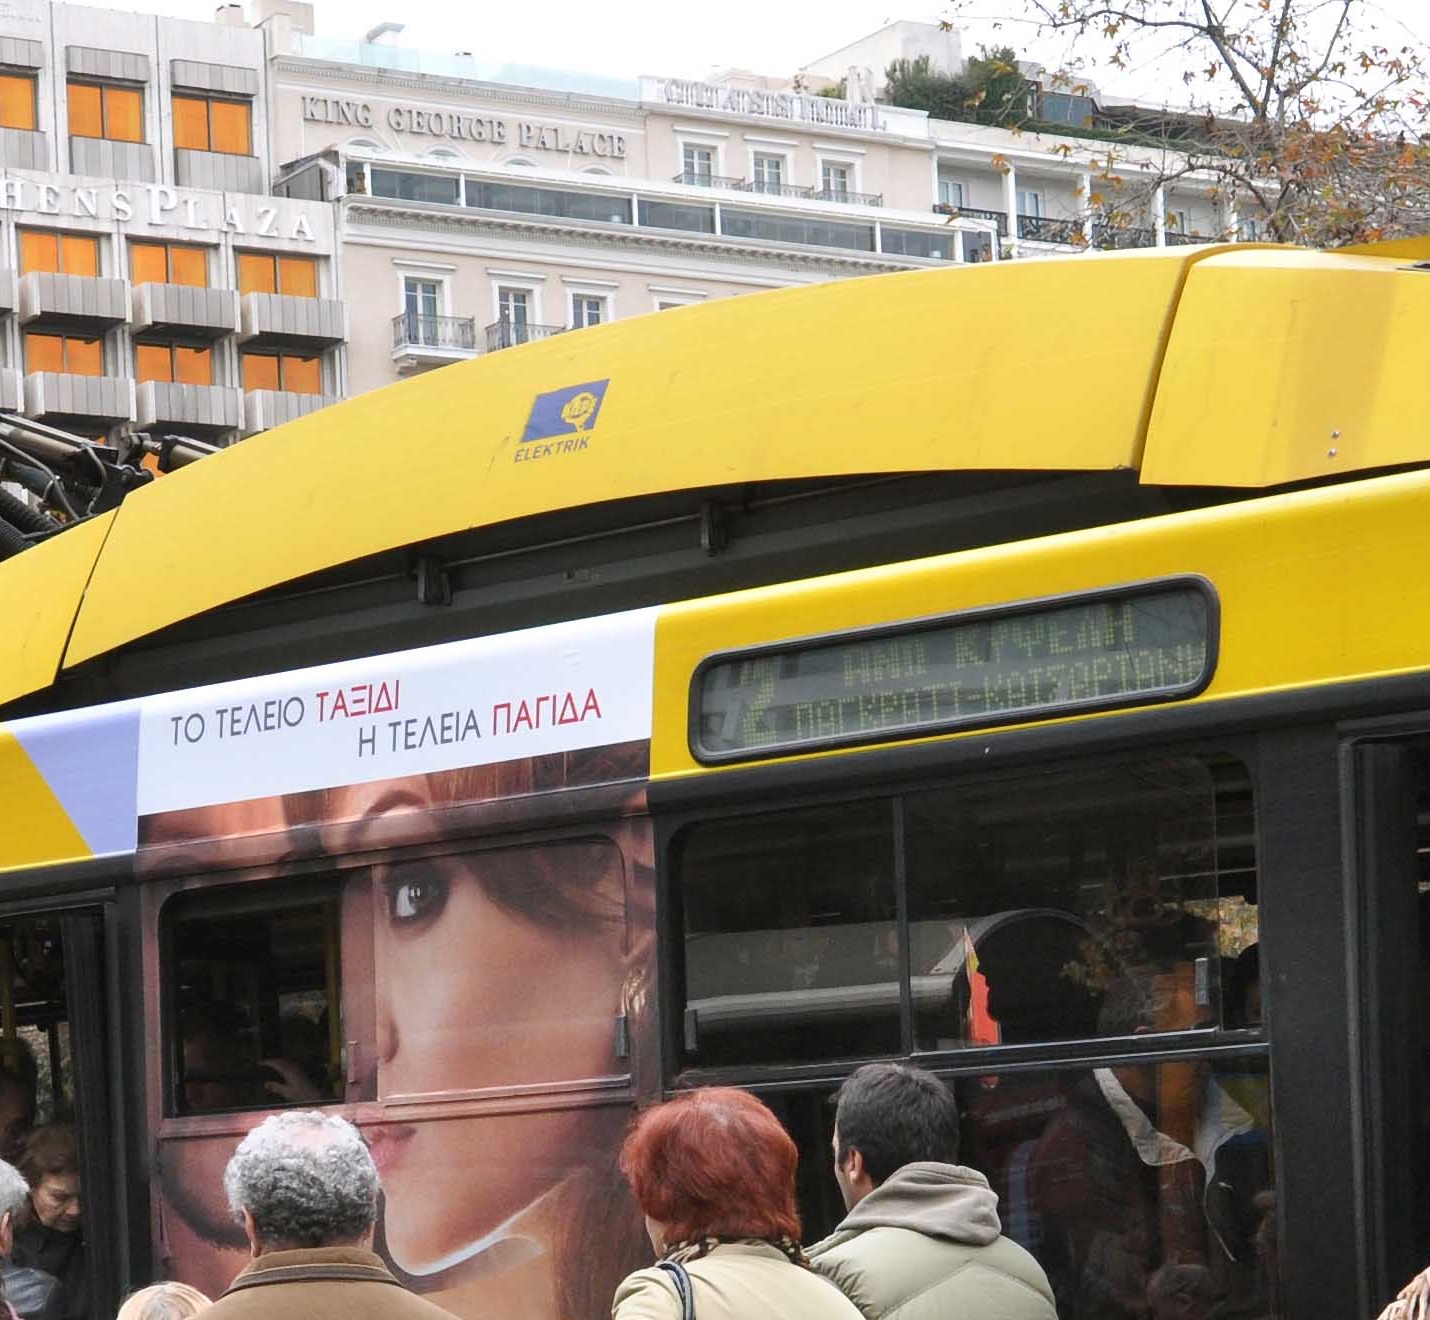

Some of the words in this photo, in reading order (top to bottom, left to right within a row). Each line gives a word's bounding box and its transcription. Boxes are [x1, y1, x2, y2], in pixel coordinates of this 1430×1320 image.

[301, 96, 373, 127] KING
[387, 107, 506, 143] GEORGE
[518, 121, 627, 158] PALACE
[146, 185, 316, 241] PLAZA
[514, 436, 589, 463] ELEKTRIK
[171, 713, 205, 745] ΤΟ
[216, 696, 305, 738] ΤΕΛΕΙΟ
[315, 679, 401, 724] ΤΑΞΙΔΙ
[387, 709, 482, 752] ΤΕΛΕΙΑ
[491, 688, 602, 736] ΠΑΓΙΔΑ
